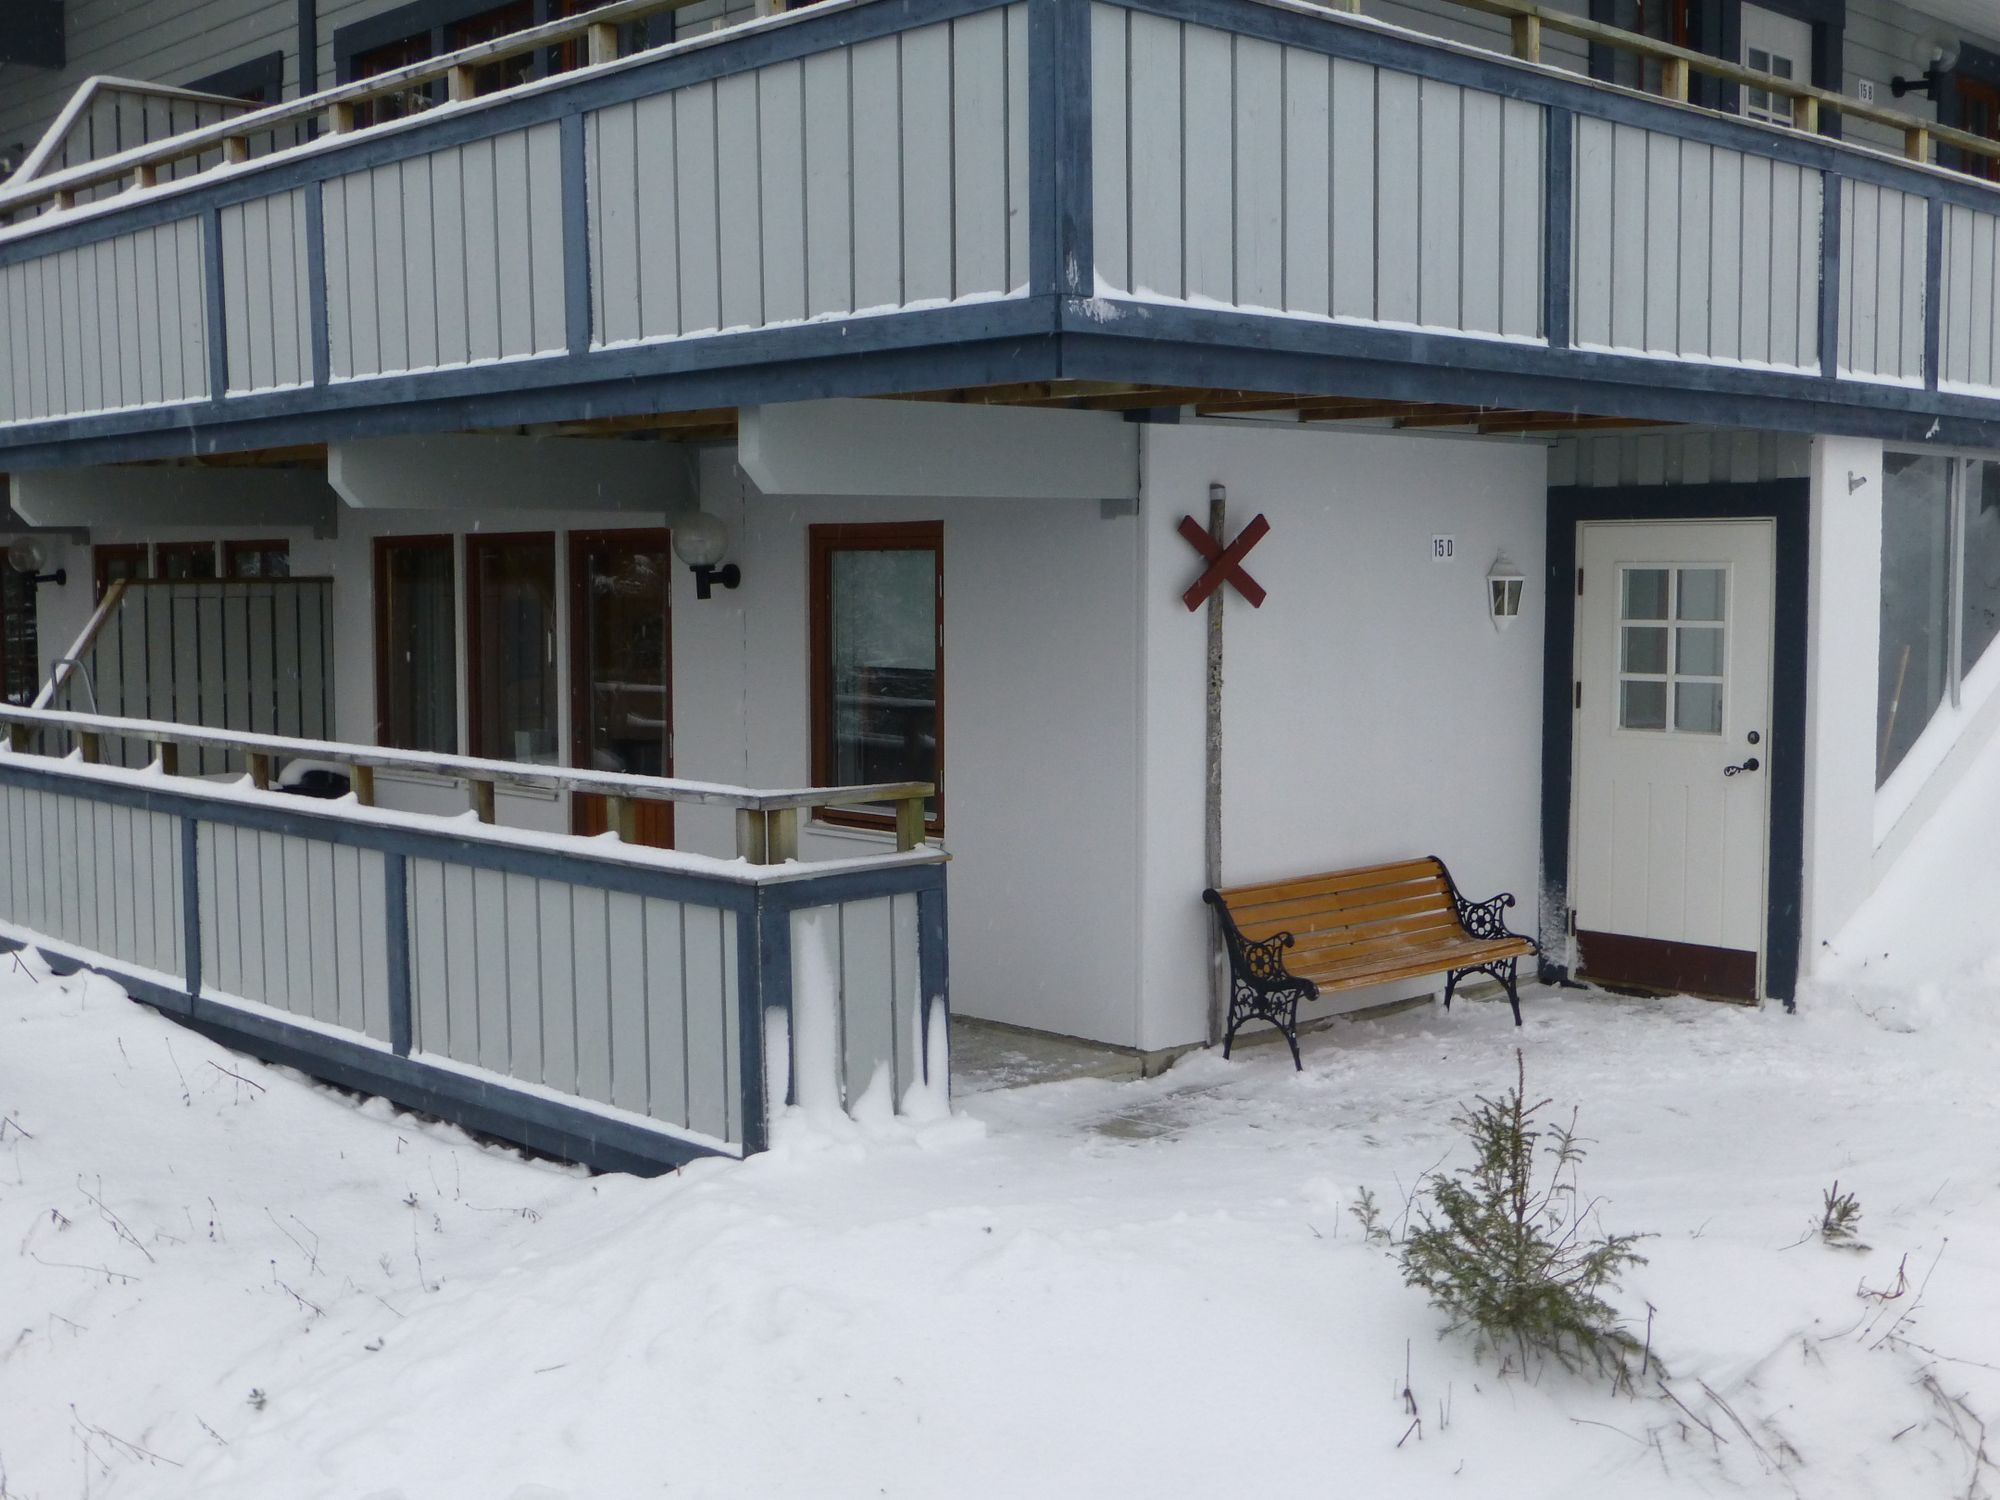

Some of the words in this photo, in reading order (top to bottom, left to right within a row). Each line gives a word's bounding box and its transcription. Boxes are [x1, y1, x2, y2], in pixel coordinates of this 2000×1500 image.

[1860, 83, 1867, 99] 15
[1434, 539, 1444, 557] 15
[1447, 539, 1453, 557] D
